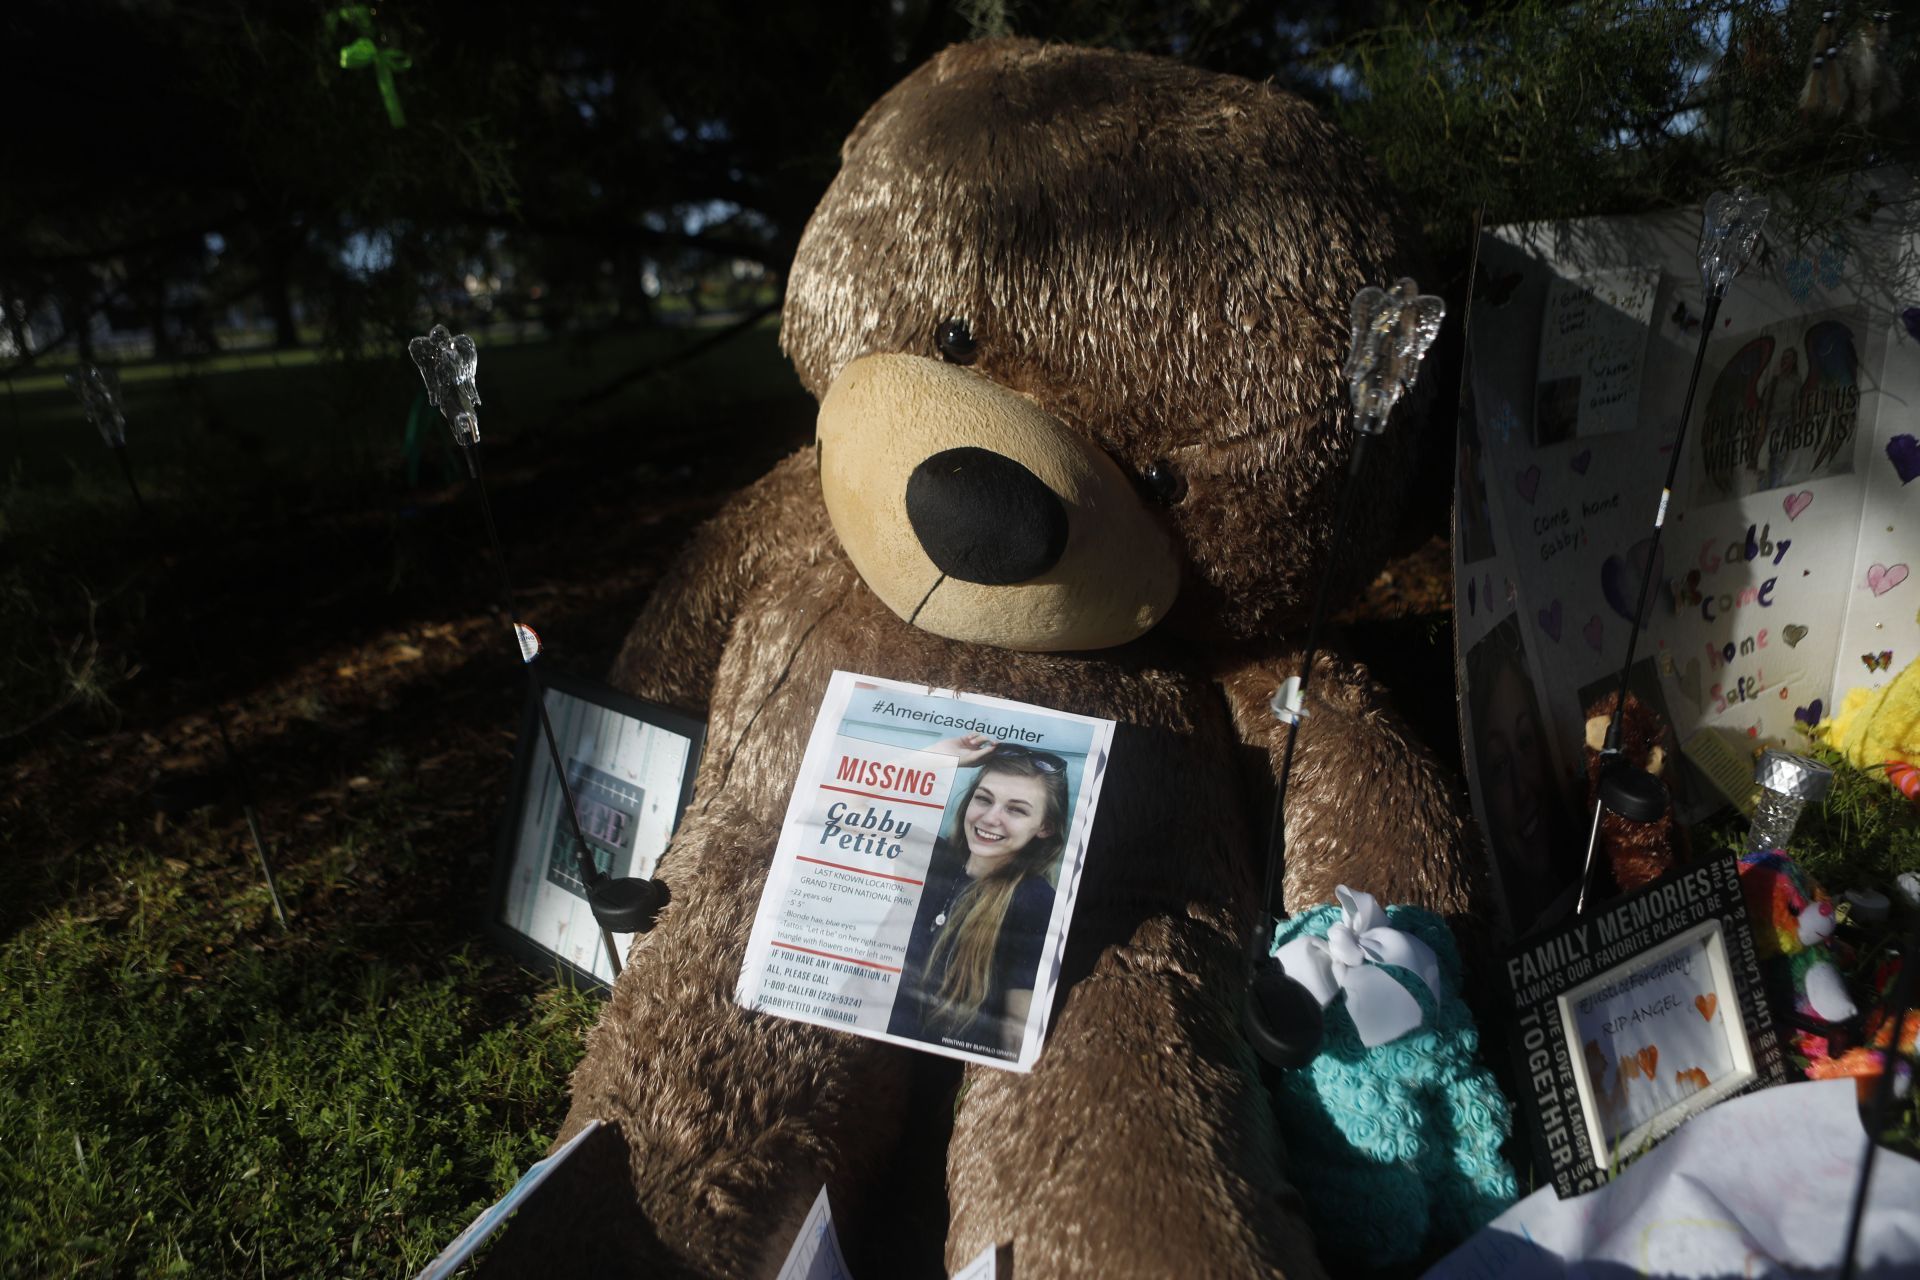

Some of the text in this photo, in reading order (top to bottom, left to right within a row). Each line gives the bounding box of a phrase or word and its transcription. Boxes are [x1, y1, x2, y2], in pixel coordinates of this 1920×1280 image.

[1769, 418, 1826, 454] GABBY
[1582, 494, 1619, 518] home
[1701, 523, 1791, 573] Gabby
[1706, 629, 1769, 672] home
[872, 699, 1045, 744] #Americasdaughter
[836, 755, 936, 796] MISSING
[825, 802, 912, 840] Gabby
[820, 822, 904, 860] Petito
[800, 876, 913, 906] GRAND TETON NATIONAL PARK
[814, 867, 832, 877] LAST
[834, 872, 864, 884] KNOWN
[1710, 861, 1721, 889] FUN
[1721, 855, 1744, 902] LOVE
[802, 891, 820, 900] years
[821, 895, 832, 903] old
[825, 919, 840, 927] blue
[840, 922, 857, 931] eyes
[848, 934, 860, 942] her
[860, 938, 877, 949] right
[892, 943, 907, 953] and
[1506, 868, 1713, 990] FAMILY MEMORIES
[771, 948, 892, 983] IF YOU HAVE ANY INFORMATION AT
[803, 937, 817, 945] with
[854, 947, 866, 957] her
[866, 949, 878, 960] left
[1515, 893, 1722, 1009] ALWAYS OUR FAVORITE PLACE TO BE
[1737, 923, 1760, 984] LAUGH
[784, 967, 811, 980] PLEASE
[812, 973, 829, 985] CALL
[1543, 999, 1561, 1038] LIVE
[1602, 994, 1682, 1034] RIP ANGEL
[1751, 986, 1773, 1029] LIVE
[1552, 1039, 1572, 1084] LOVE
[1519, 1007, 1574, 1172] TOGETHER
[1563, 1086, 1576, 1099] &
[1566, 1100, 1593, 1161] LAUGH
